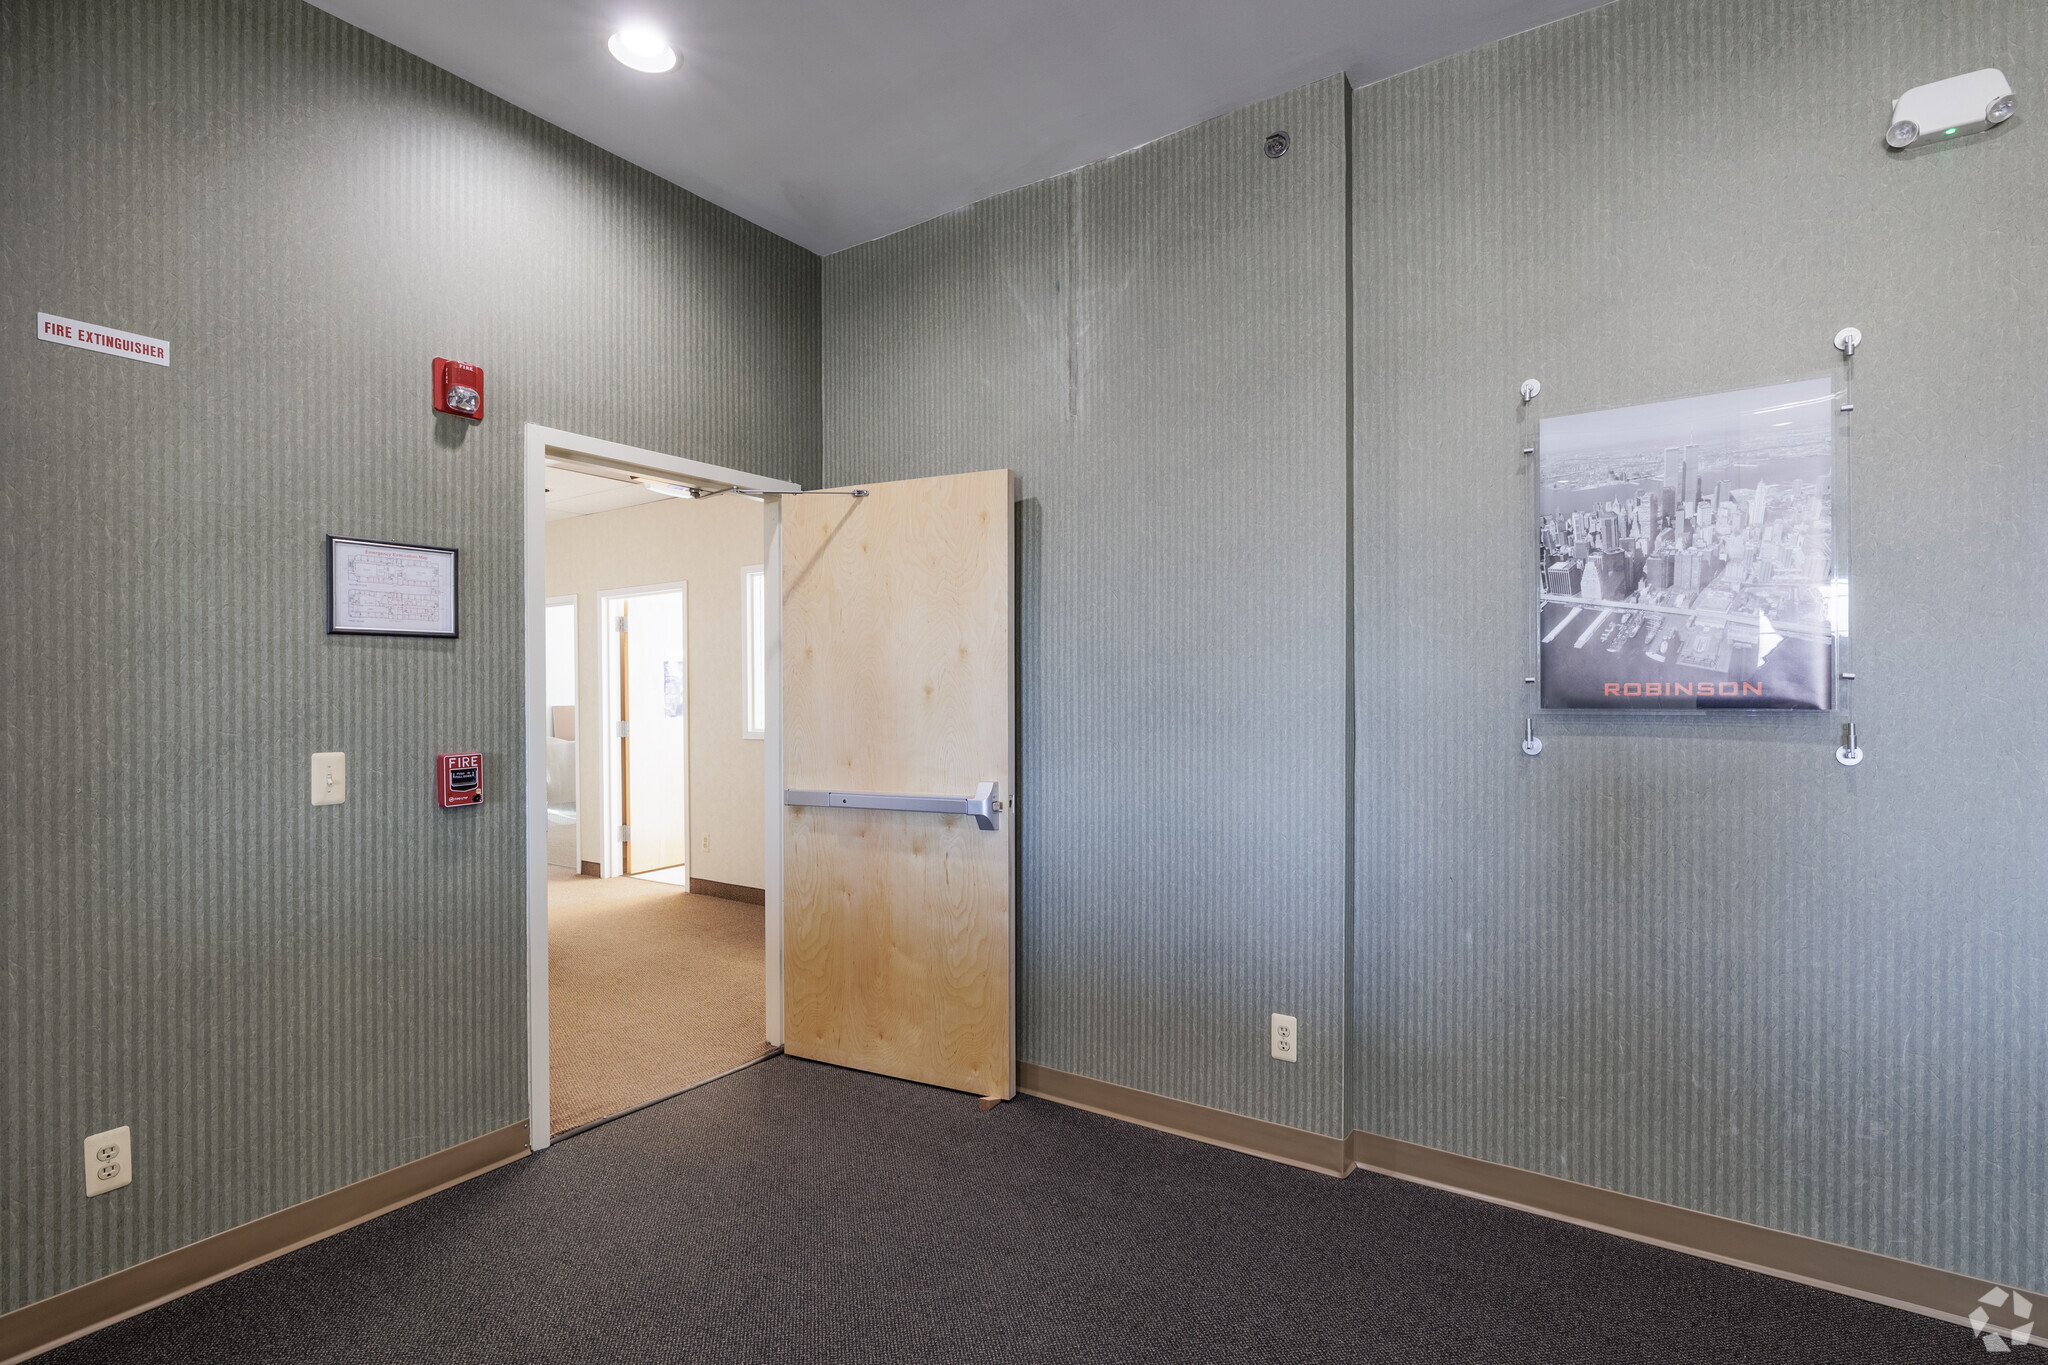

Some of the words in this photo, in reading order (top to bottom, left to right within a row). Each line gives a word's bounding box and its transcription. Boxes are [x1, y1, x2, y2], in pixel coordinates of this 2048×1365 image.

[44, 321, 72, 339] FIRE
[78, 329, 164, 359] EXTINGUISHER
[459, 364, 473, 372] FIRE
[1604, 681, 1763, 697] ROBINSON
[449, 756, 478, 768] FIRE
